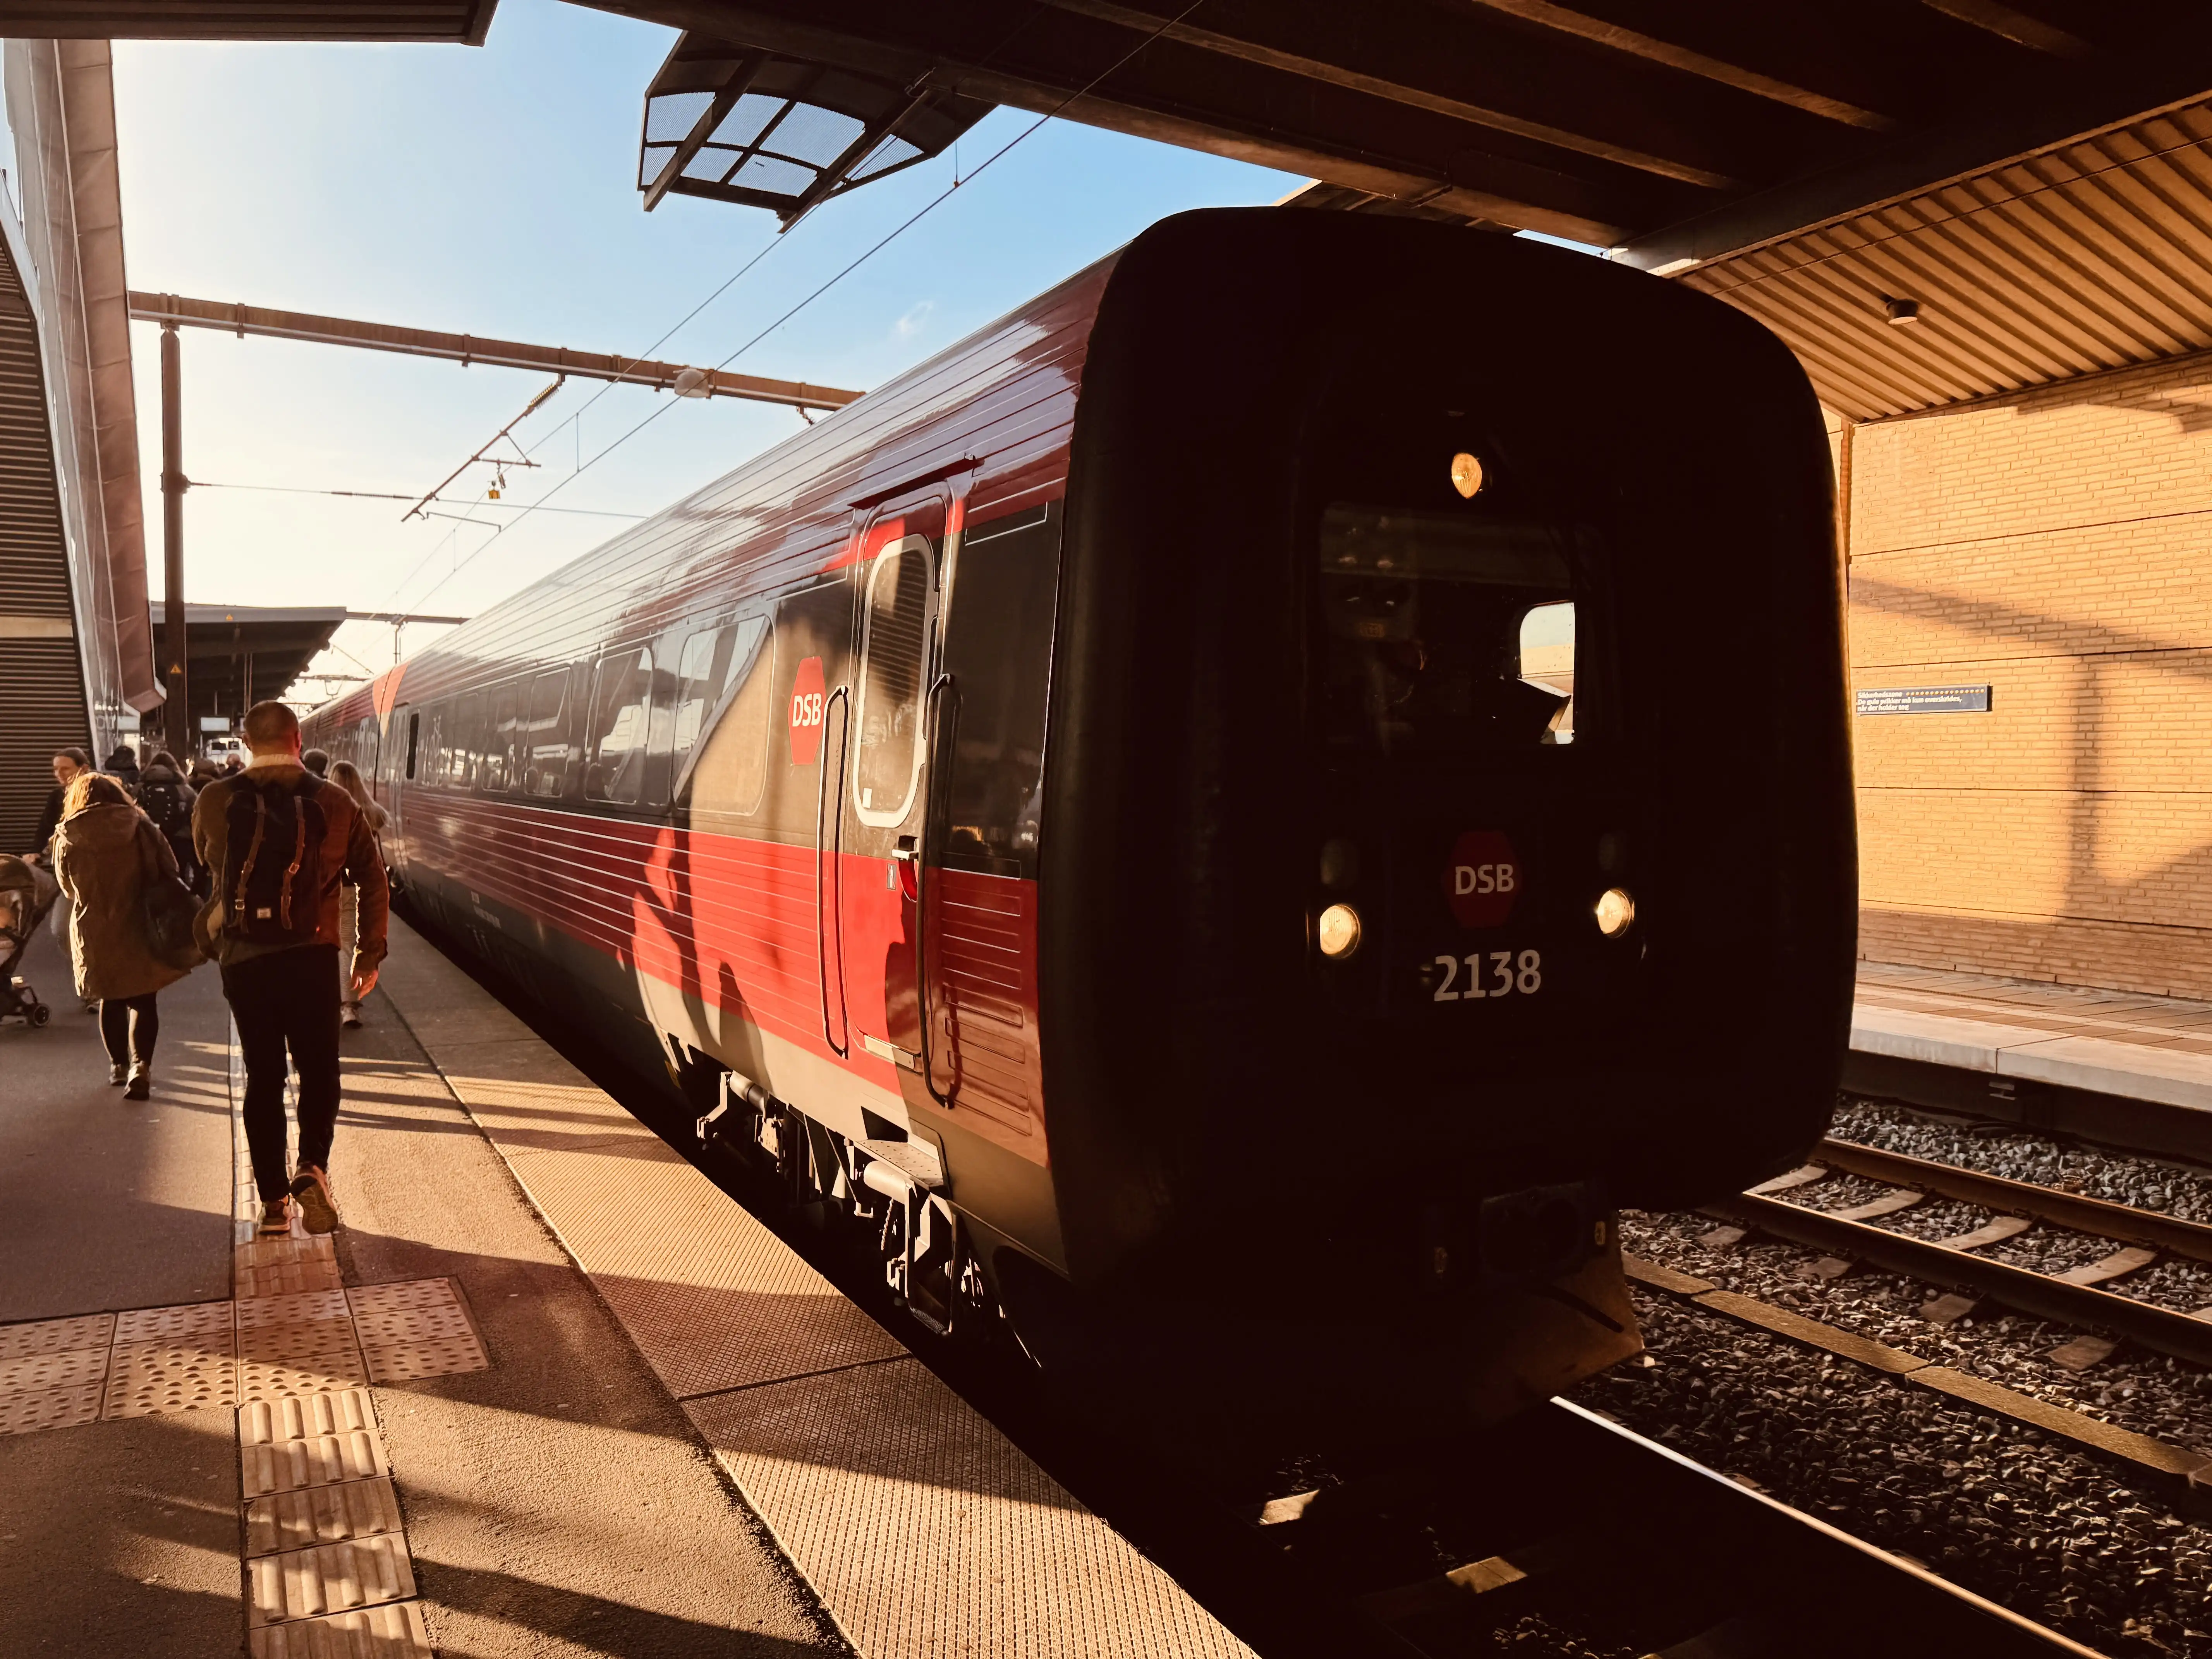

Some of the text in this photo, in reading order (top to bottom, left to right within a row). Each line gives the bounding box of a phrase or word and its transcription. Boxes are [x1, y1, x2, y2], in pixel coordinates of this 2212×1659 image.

[792, 693, 822, 727] DSB
[1455, 864, 1514, 895] DSB
[1434, 949, 1541, 1002] 2138
